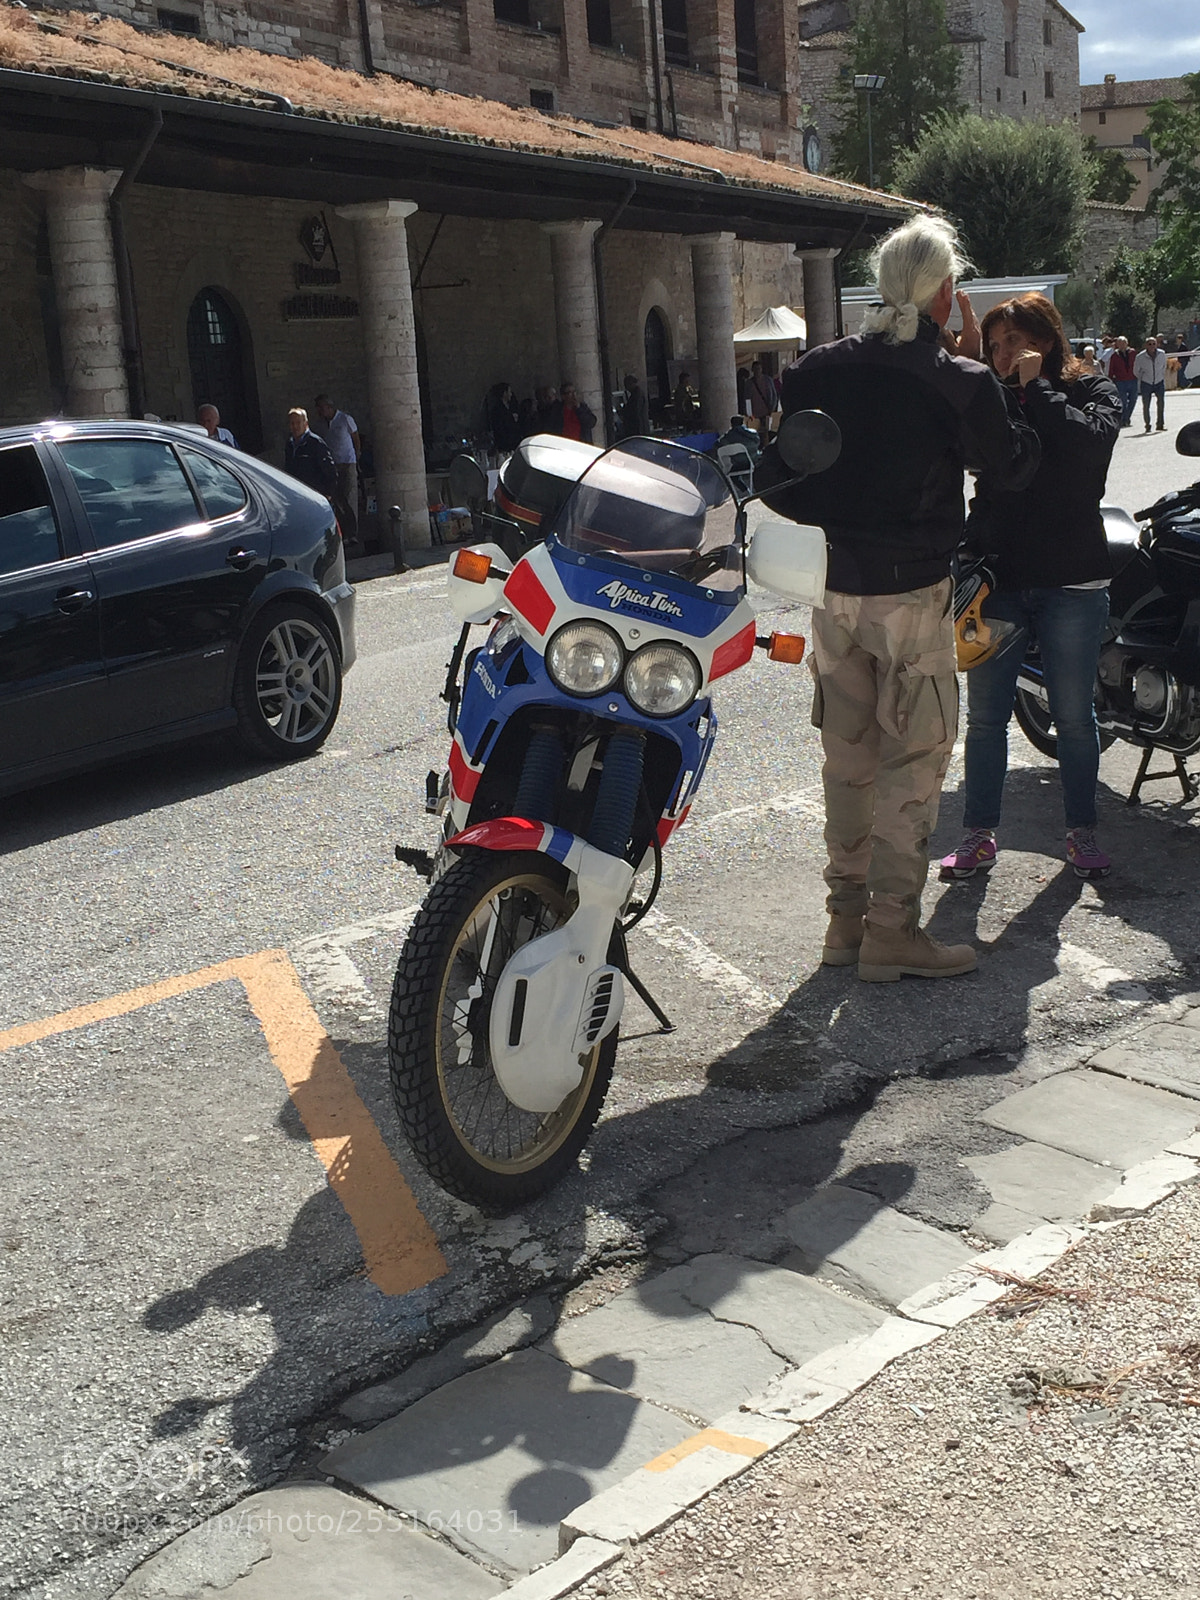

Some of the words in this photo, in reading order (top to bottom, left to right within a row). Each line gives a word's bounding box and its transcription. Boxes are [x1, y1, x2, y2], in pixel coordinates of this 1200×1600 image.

[596, 580, 651, 608] Africa
[650, 591, 683, 617] Twin
[621, 603, 673, 623] HONDA
[474, 661, 496, 699] HONDA
